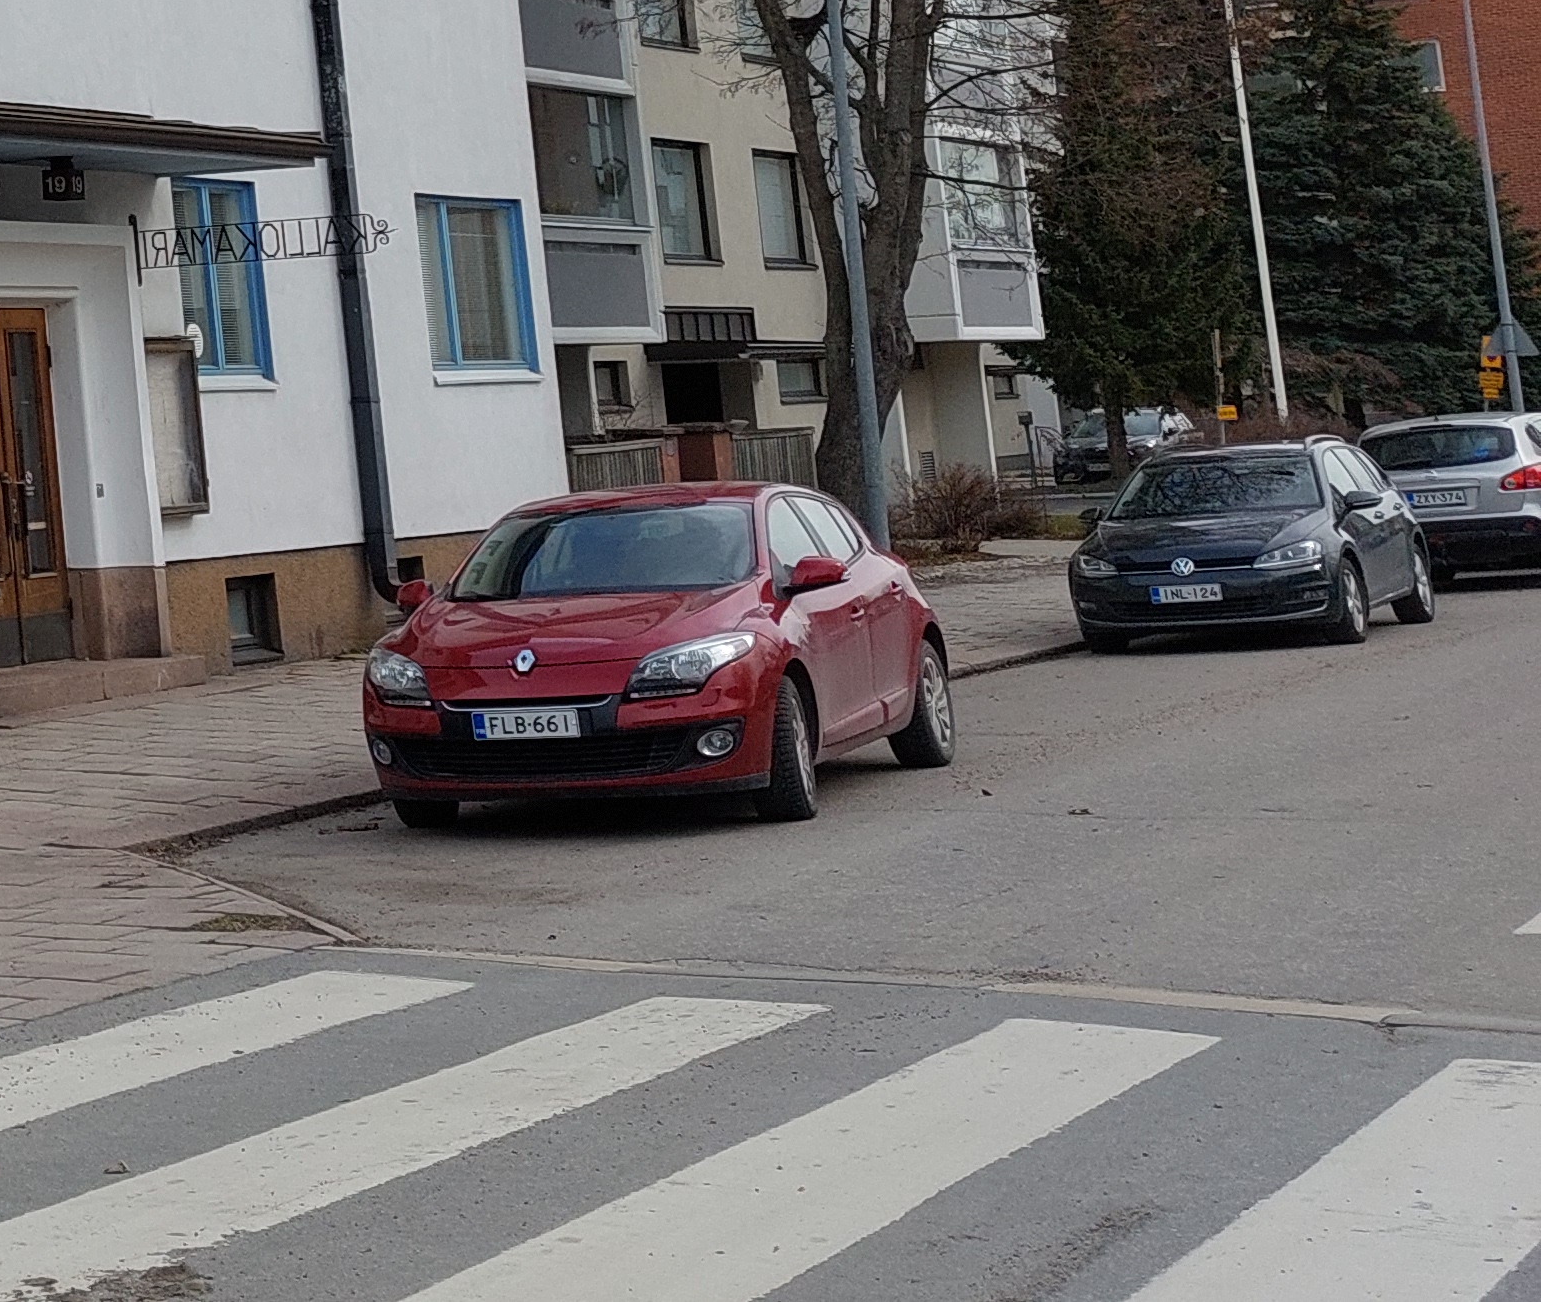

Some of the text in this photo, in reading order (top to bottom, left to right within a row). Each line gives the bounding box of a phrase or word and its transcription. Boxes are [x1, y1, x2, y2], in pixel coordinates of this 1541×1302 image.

[45, 176, 66, 193] 19
[71, 175, 83, 194] 19
[1416, 492, 1463, 504] ZXY-374
[1163, 586, 1218, 601] INL-124
[488, 714, 569, 735] FLB-661
